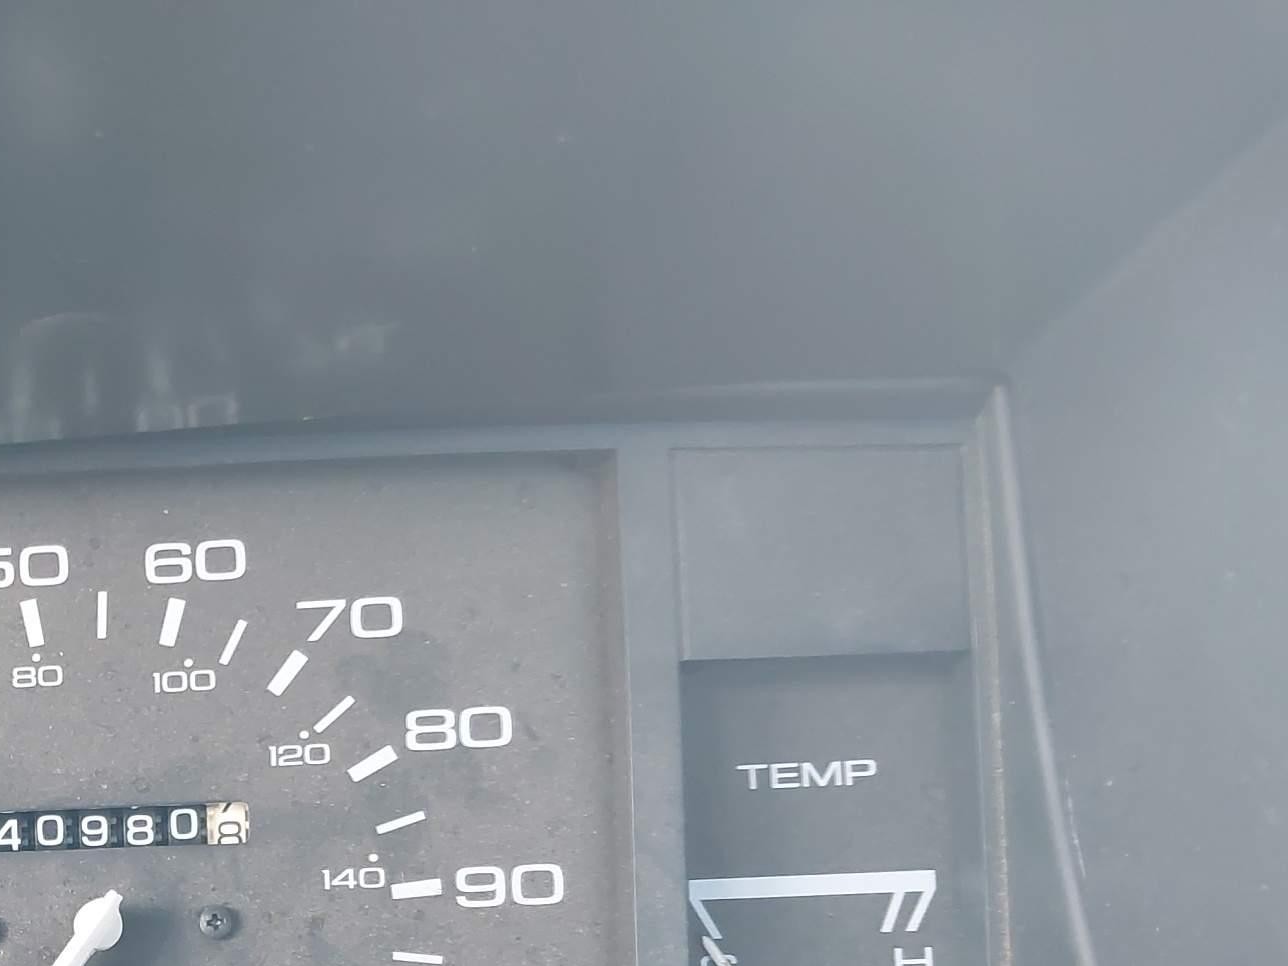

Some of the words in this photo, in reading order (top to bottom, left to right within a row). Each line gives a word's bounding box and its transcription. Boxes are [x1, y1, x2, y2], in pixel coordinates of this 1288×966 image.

[145, 539, 246, 583] 60
[297, 597, 402, 641] 70
[12, 665, 62, 687] 80
[153, 670, 215, 693] 100
[406, 706, 512, 750] 80
[269, 744, 330, 766] 120
[737, 760, 877, 789] TEMP
[322, 868, 385, 889] 140
[456, 864, 564, 907] 90
